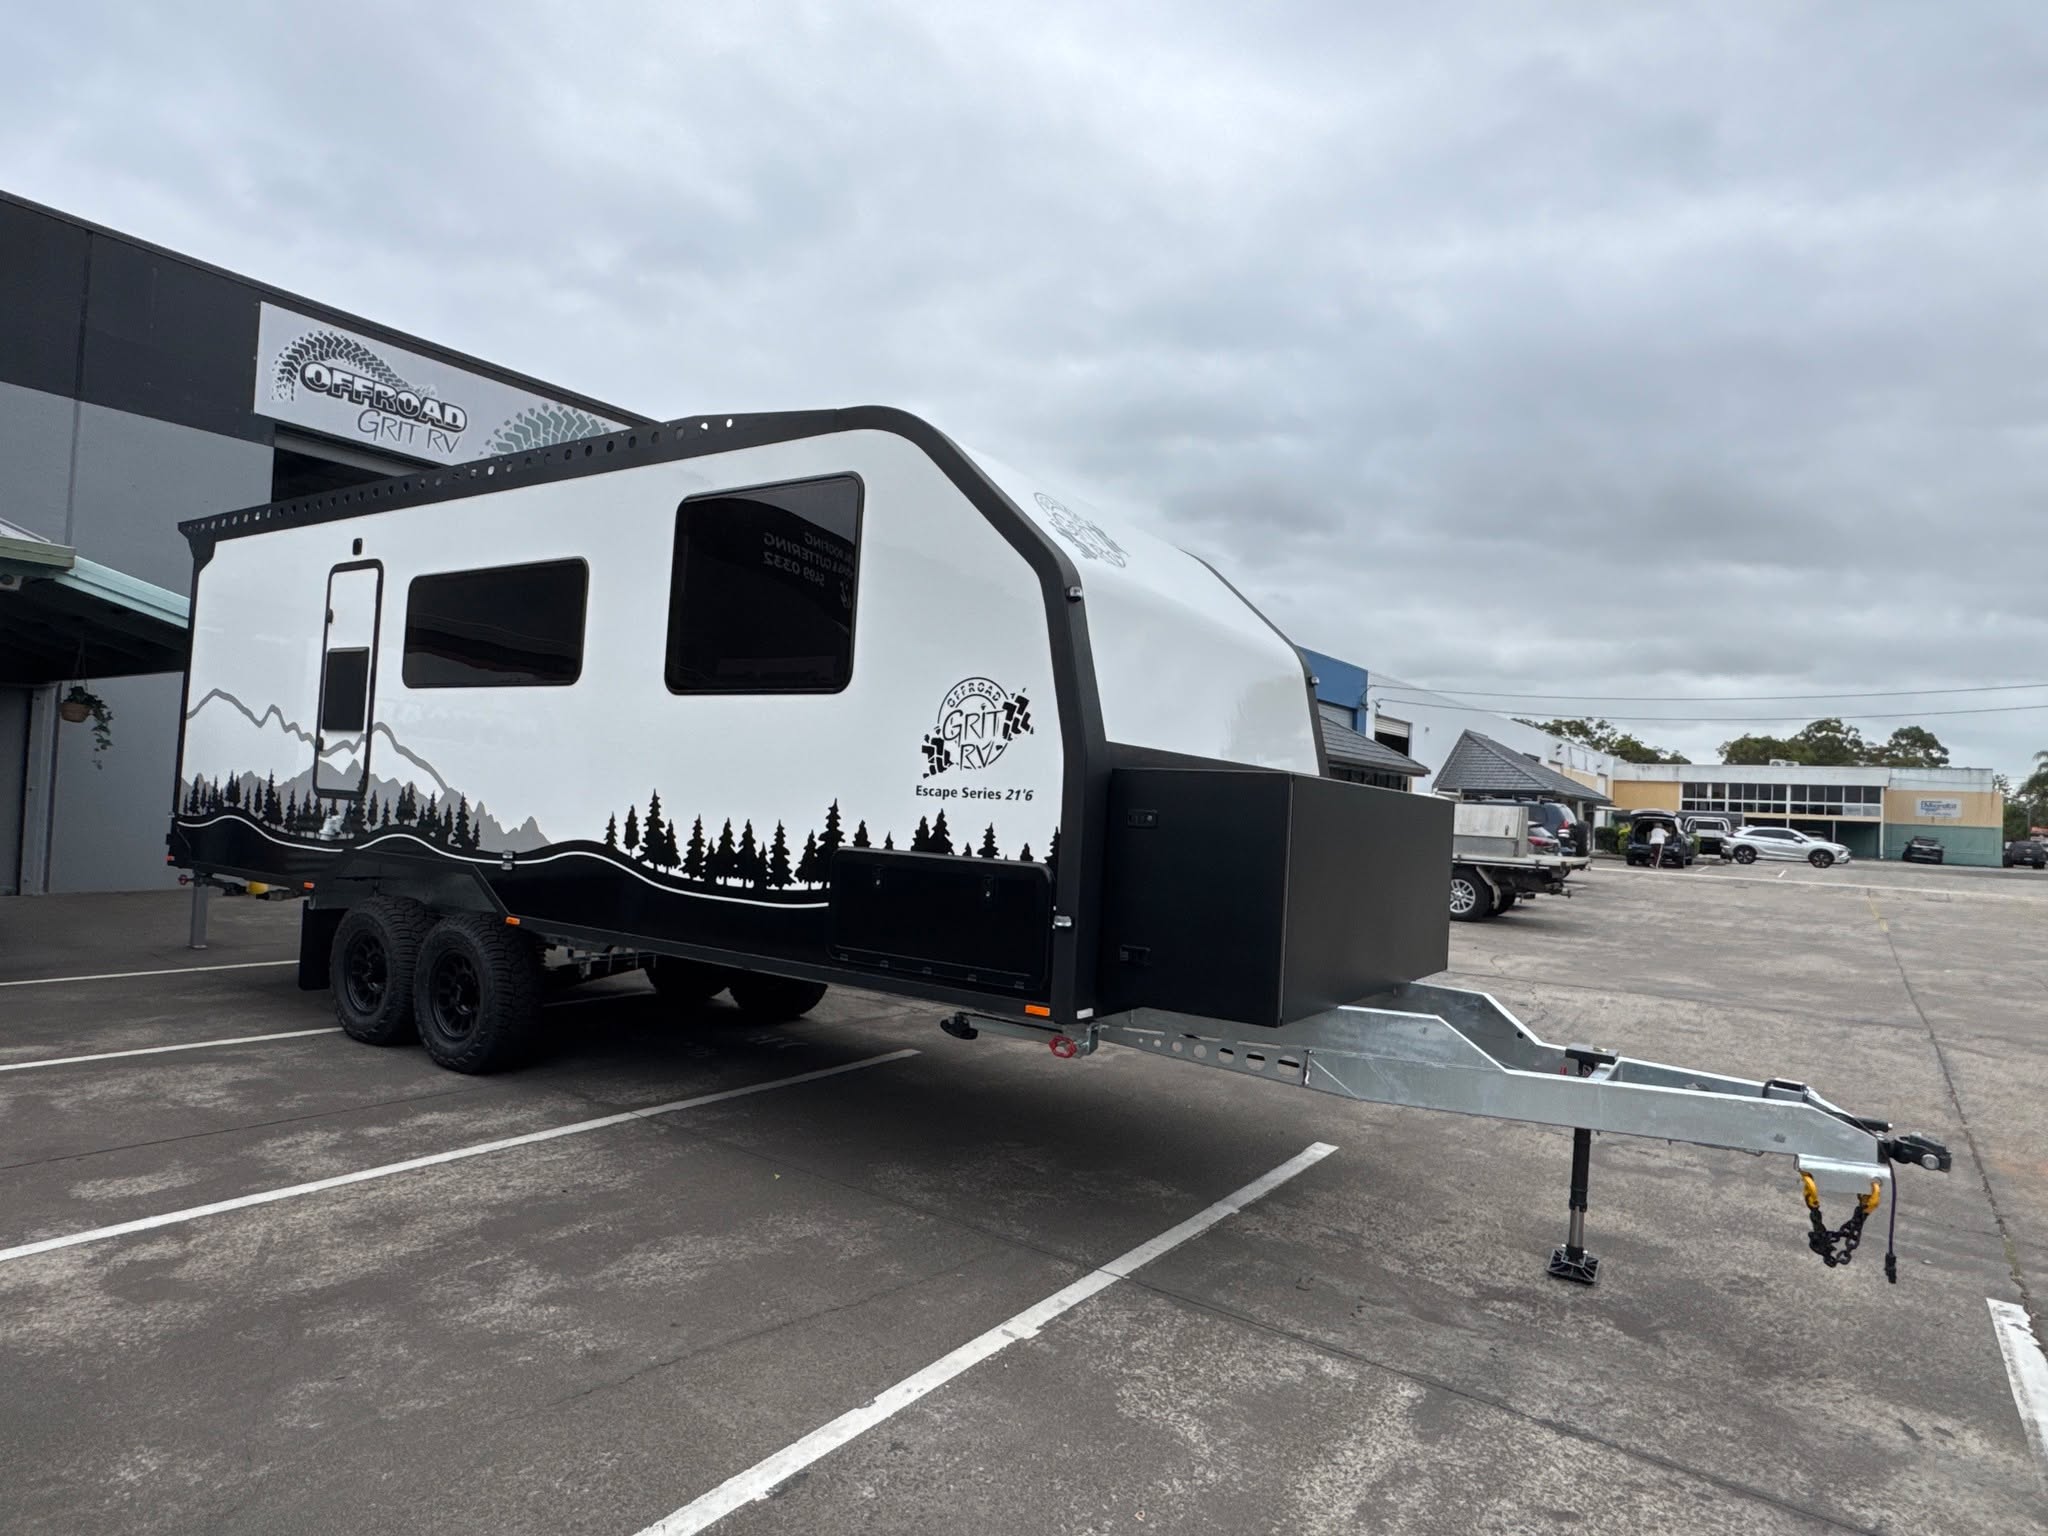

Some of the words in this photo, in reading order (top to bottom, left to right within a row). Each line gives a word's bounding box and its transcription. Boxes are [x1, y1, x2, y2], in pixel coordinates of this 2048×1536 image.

[300, 361, 467, 432] OFFROAD
[357, 410, 421, 444] GRIT
[427, 431, 462, 455] RV
[947, 682, 1001, 708] OFFROAD
[942, 709, 1004, 747] GRIT
[960, 740, 994, 770] RV
[916, 785, 958, 800] Escape
[962, 787, 1001, 800] Series
[1005, 789, 1034, 801] 21'6
